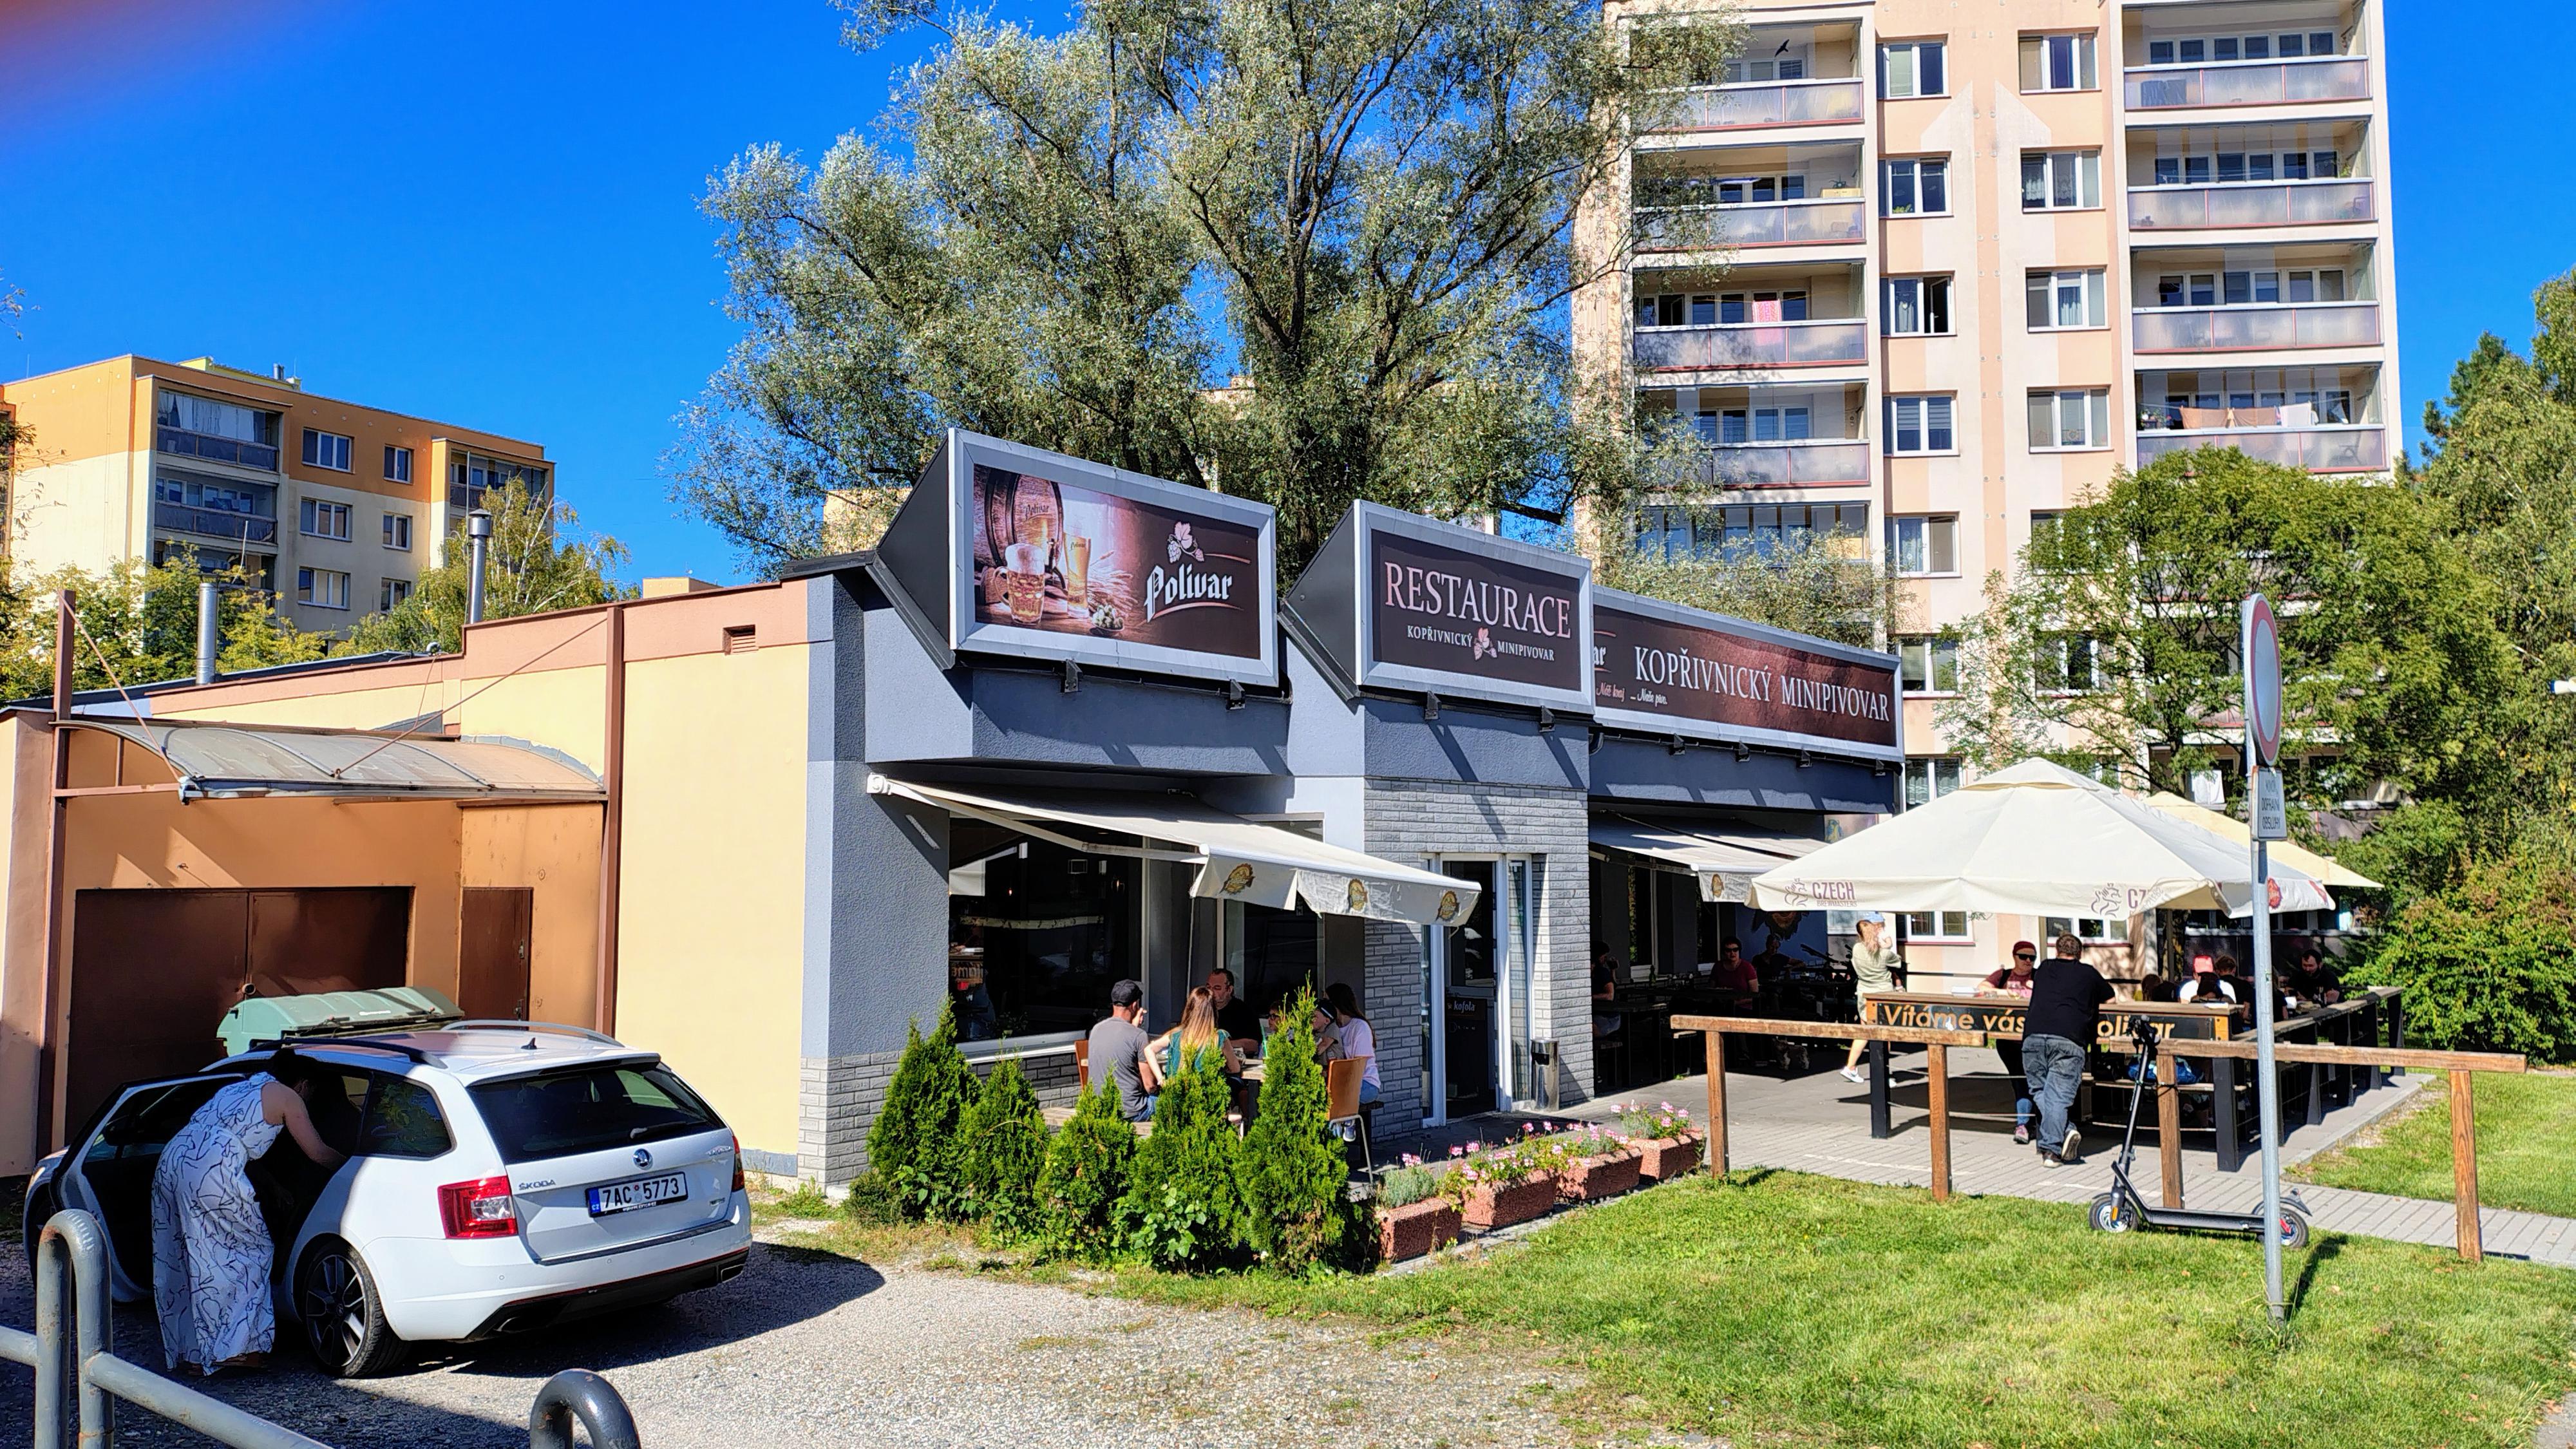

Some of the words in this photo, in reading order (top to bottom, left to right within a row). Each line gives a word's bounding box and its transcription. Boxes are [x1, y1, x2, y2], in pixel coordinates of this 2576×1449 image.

[1143, 564, 1233, 623] Polivar
[1384, 561, 1571, 639] RESTAURACE
[1406, 623, 1473, 648] KOPŘIVNICKÝ
[1497, 640, 1555, 661] MINIPIVOVAR
[1634, 646, 1772, 703] KOPŘIVNICKÝ
[1781, 674, 1890, 722] MINIPIVOVAR
[1812, 882, 1855, 900] CZECH
[1454, 1000, 1475, 1014] kofola
[1884, 1004, 1975, 1030] Vítáme
[1983, 1009, 2026, 1032] vás
[518, 1179, 557, 1191] ŠKODA
[602, 1186, 632, 1209] 7AC
[643, 1177, 679, 1200] 5773
